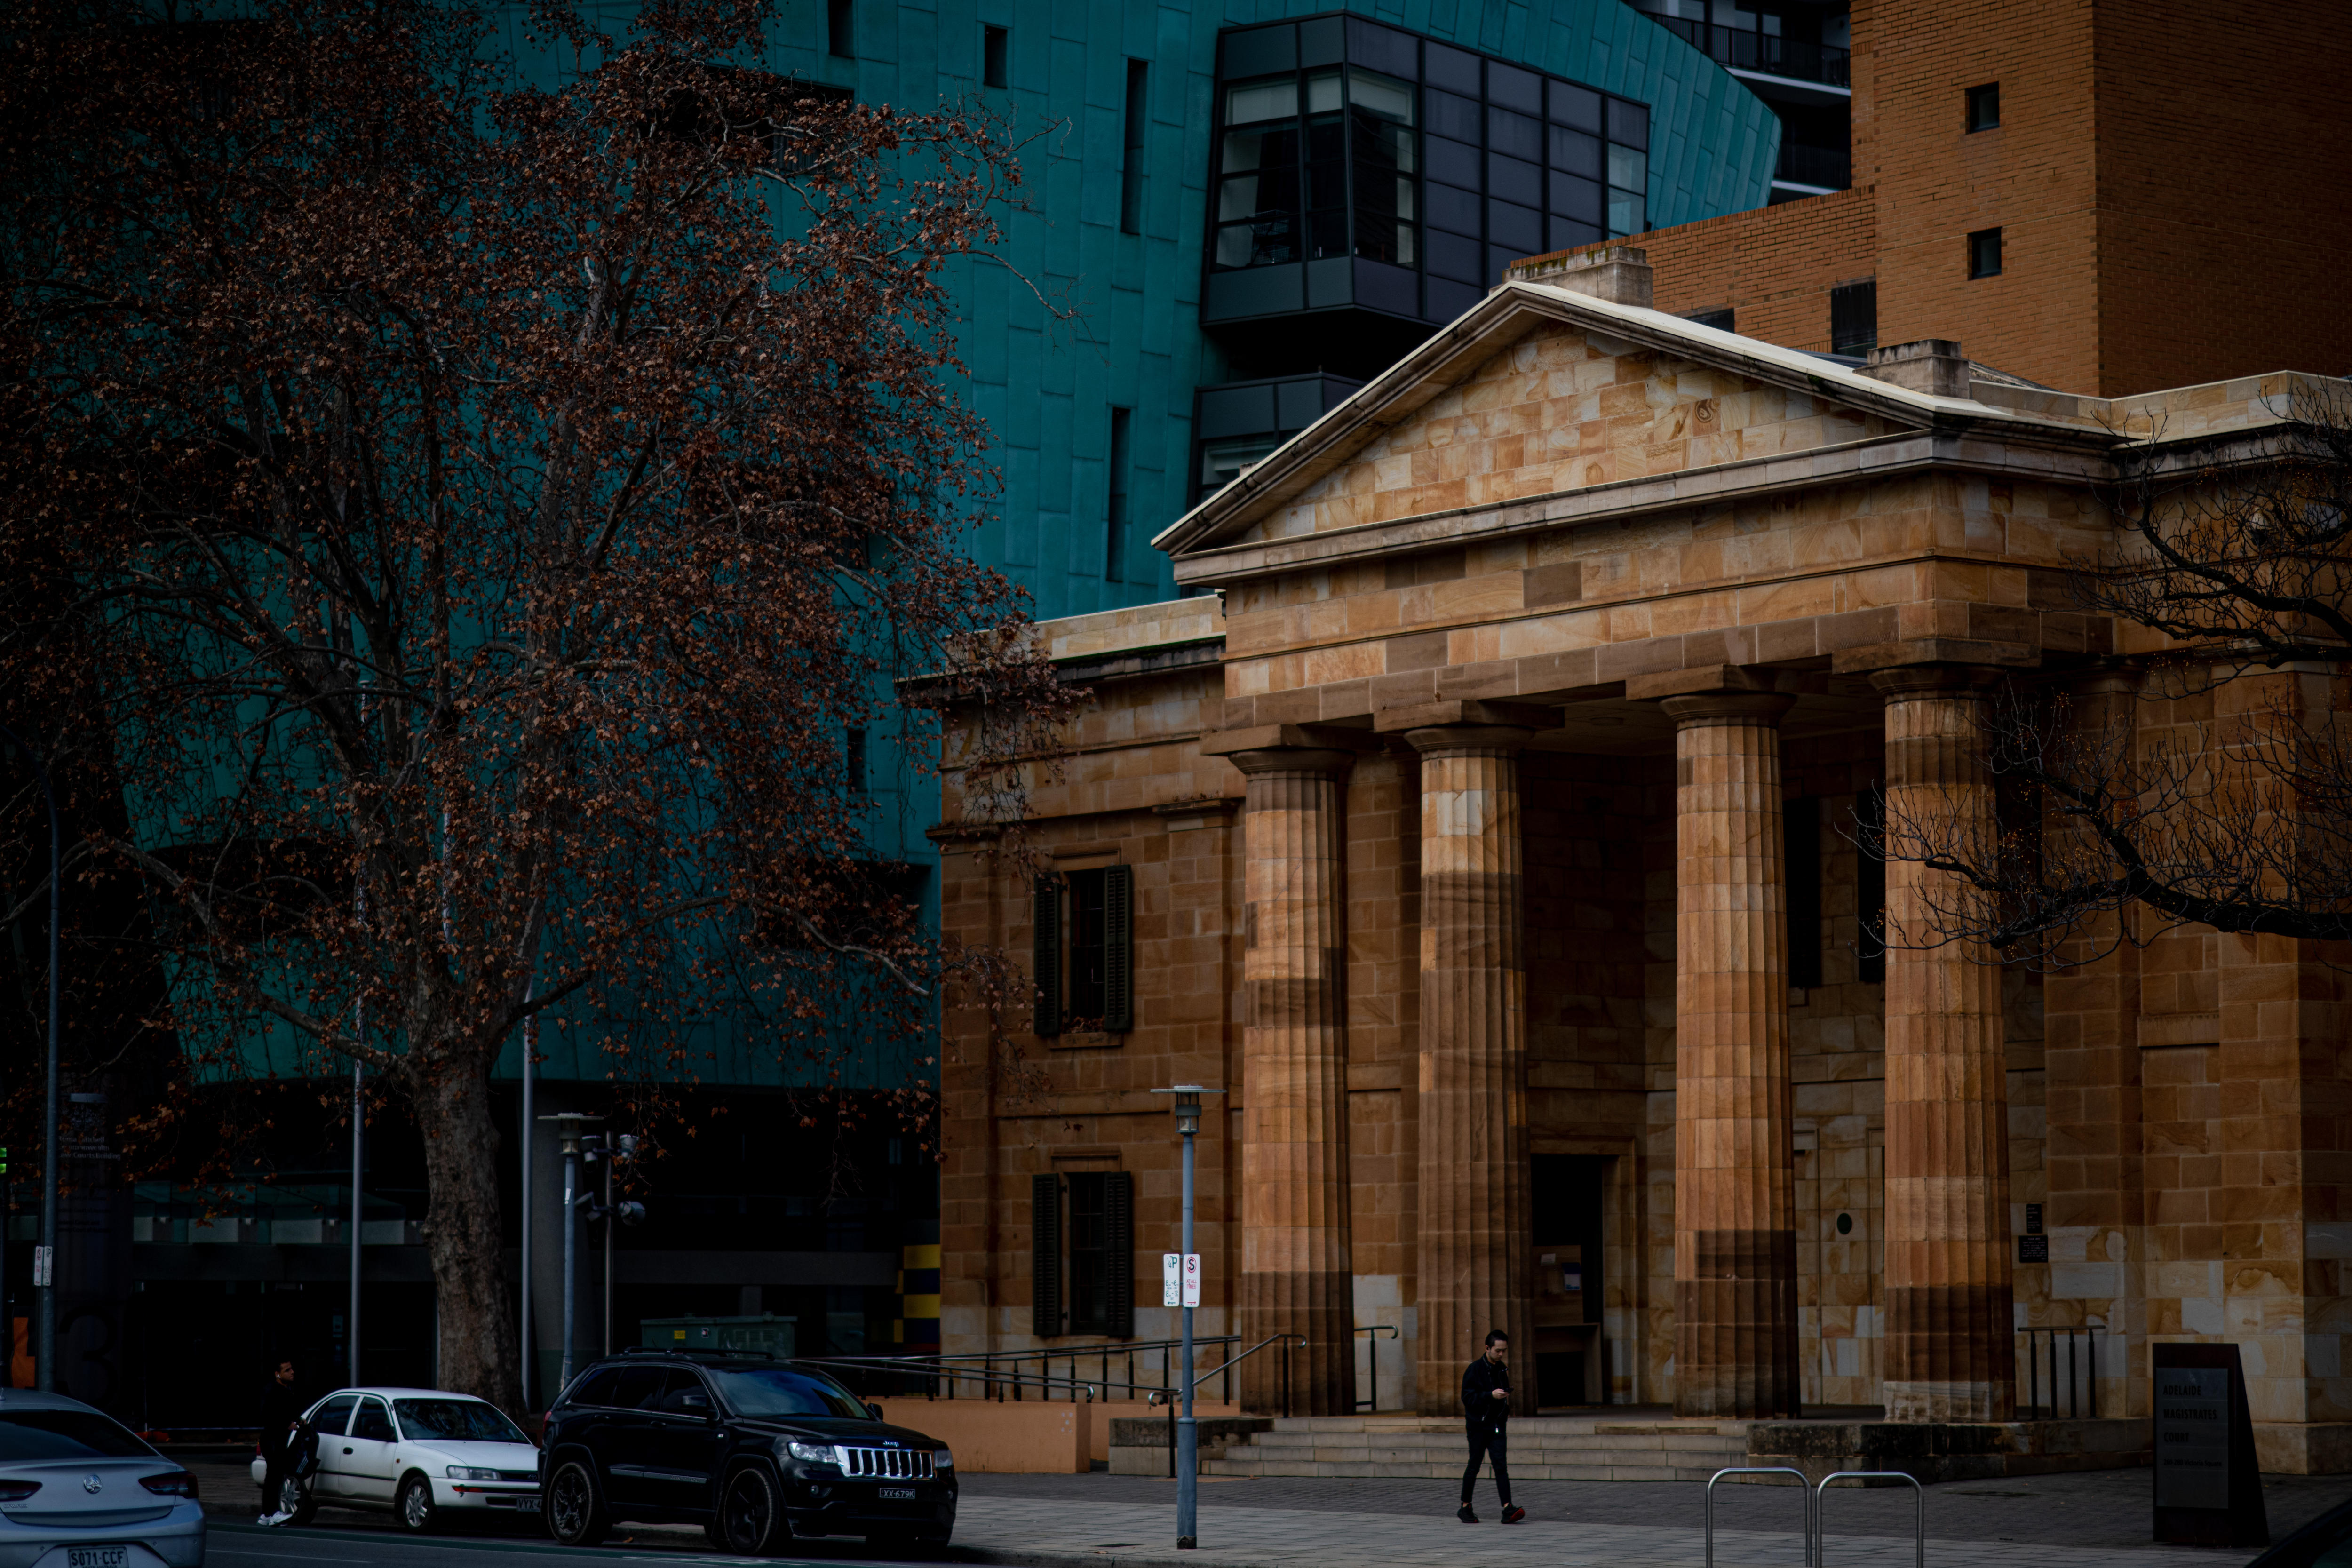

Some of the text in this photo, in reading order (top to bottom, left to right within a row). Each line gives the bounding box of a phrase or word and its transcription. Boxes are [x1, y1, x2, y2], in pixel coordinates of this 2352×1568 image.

[96, 1152, 121, 1161] Building
[2163, 1385, 2201, 1395] ADELAIDE
[2163, 1409, 2217, 1419] MAGISTRATES
[2163, 1432, 2189, 1442] COURT
